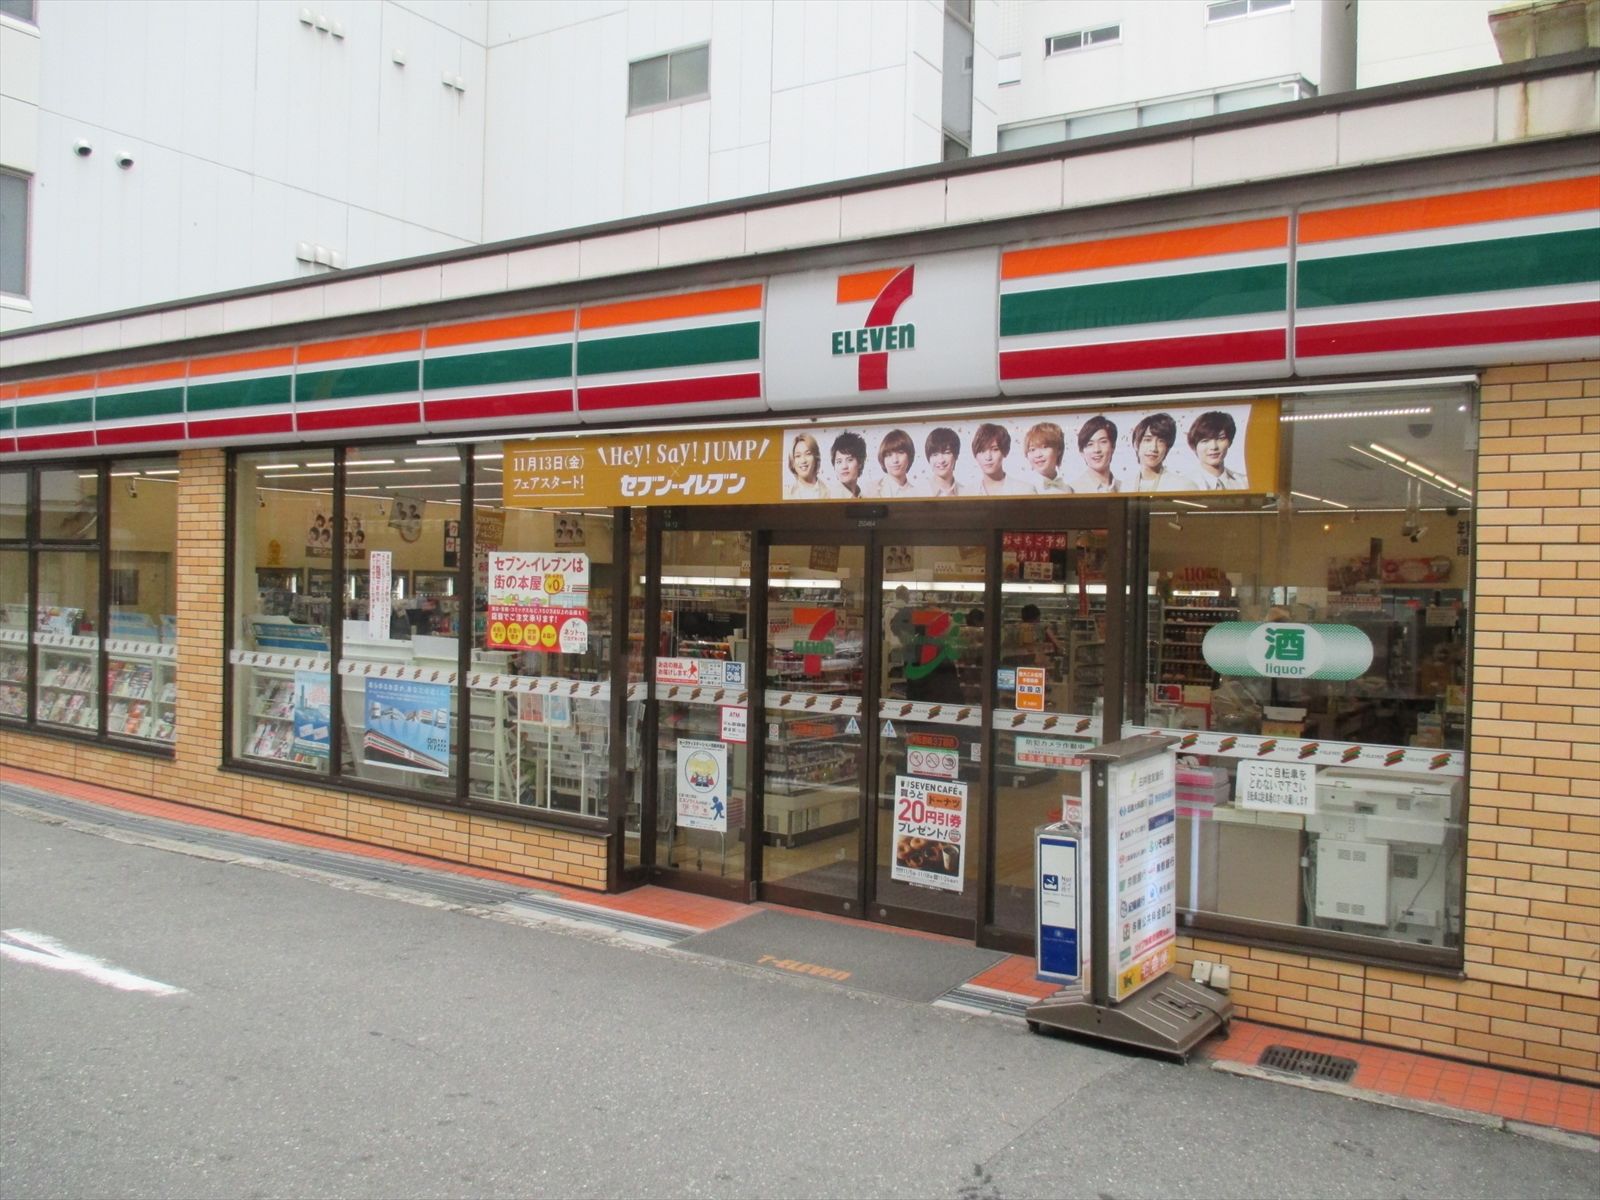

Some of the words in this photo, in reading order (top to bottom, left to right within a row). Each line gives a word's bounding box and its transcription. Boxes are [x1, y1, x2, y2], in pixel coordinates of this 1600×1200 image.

[836, 264, 915, 391] 7
[610, 446, 652, 468] Hey!
[657, 441, 697, 467] Say!
[701, 440, 757, 465] JUMP
[513, 455, 585, 472] 11月13日(金)
[513, 475, 584, 491] フェアスタート!
[621, 473, 746, 497] セブン-イレブン
[494, 556, 584, 572] セブン-イレブンは
[494, 574, 542, 591] 街の本屋
[1265, 627, 1305, 661] 酒
[1265, 663, 1305, 675] liquor
[1249, 766, 1307, 781] ここに自転車を
[910, 781, 936, 792] SEVEN
[937, 784, 958, 795] CAFÉ
[900, 788, 924, 799] 買うと
[928, 795, 961, 809] ドーナツ
[898, 798, 962, 828] 20円引券
[898, 822, 948, 840] プレゼント!
